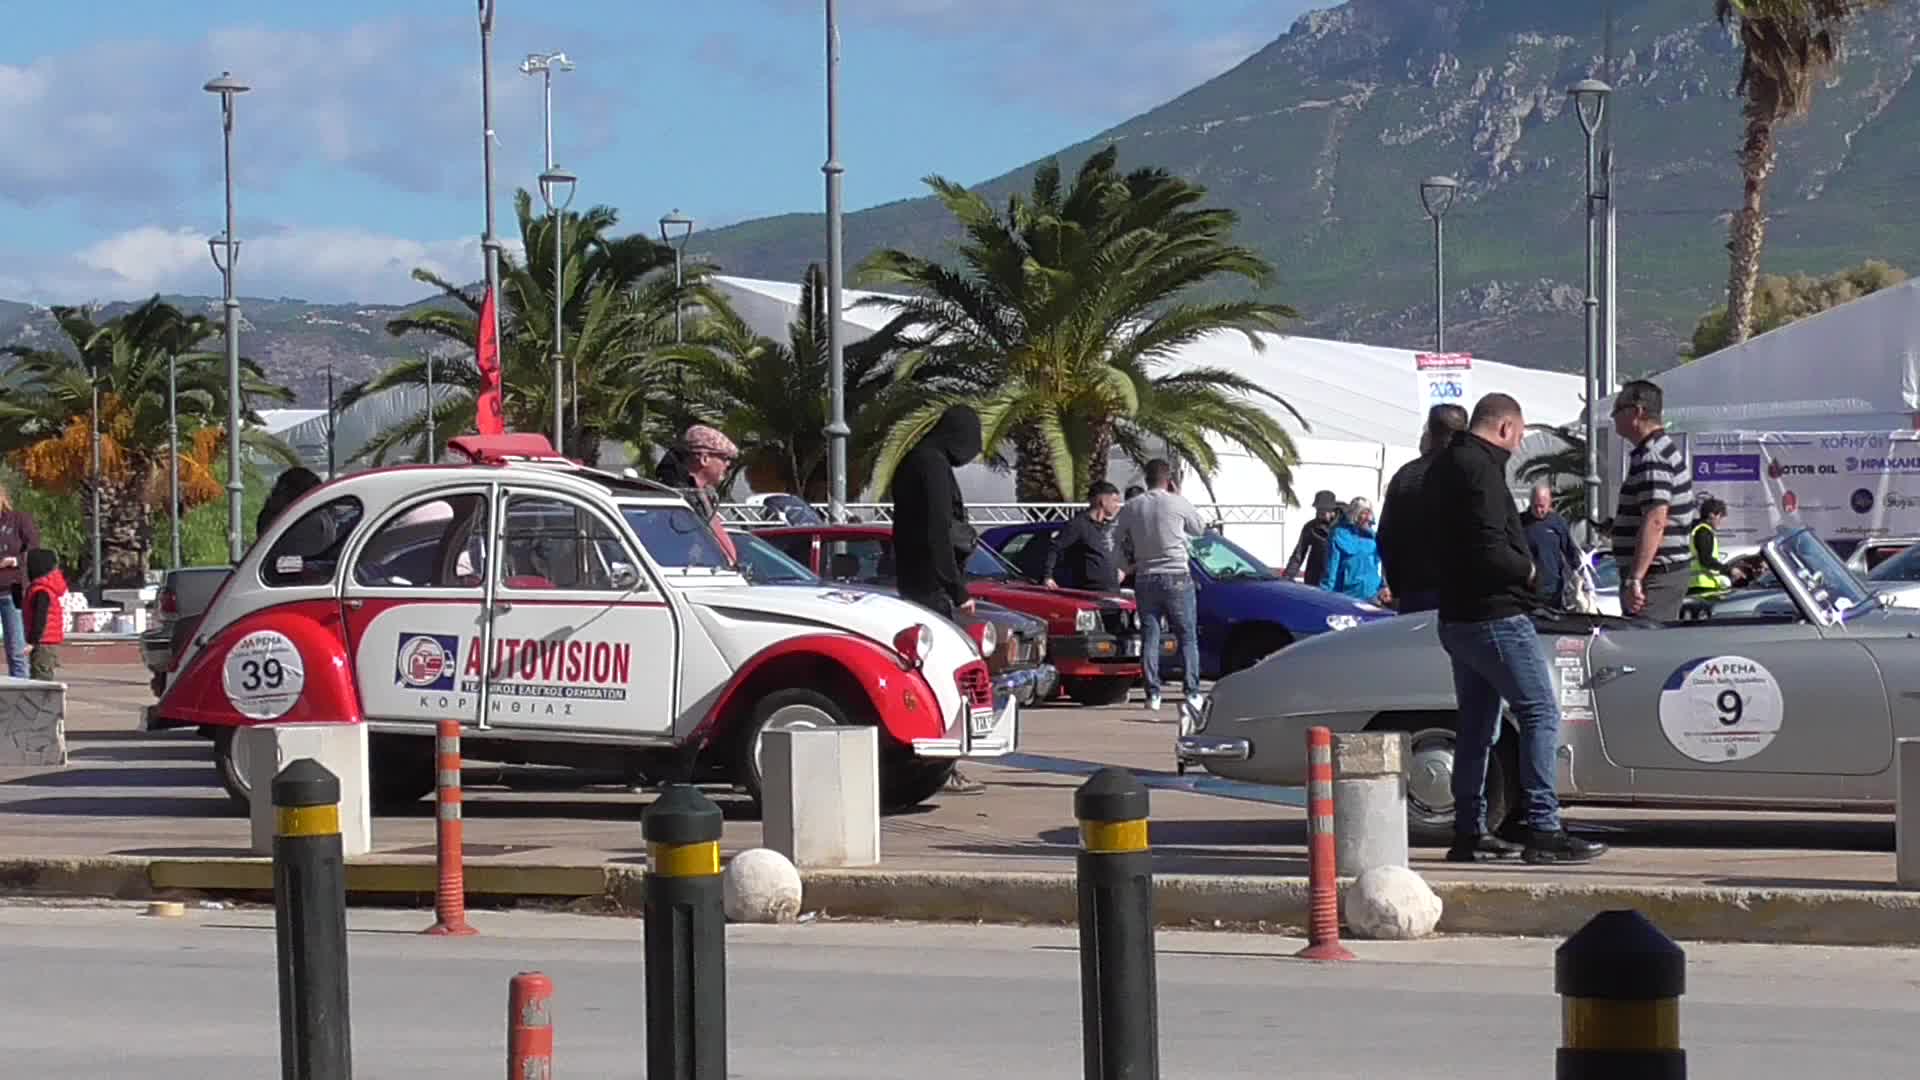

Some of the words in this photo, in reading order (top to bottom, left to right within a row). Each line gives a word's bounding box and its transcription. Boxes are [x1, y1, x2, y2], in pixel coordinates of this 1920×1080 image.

[1818, 464, 1838, 475] OIL
[241, 658, 283, 691] 39
[464, 636, 630, 683] AUTOVISION
[420, 696, 573, 714] ΚΟΡΝΘΙΑΣ
[1716, 689, 1743, 726] 9
